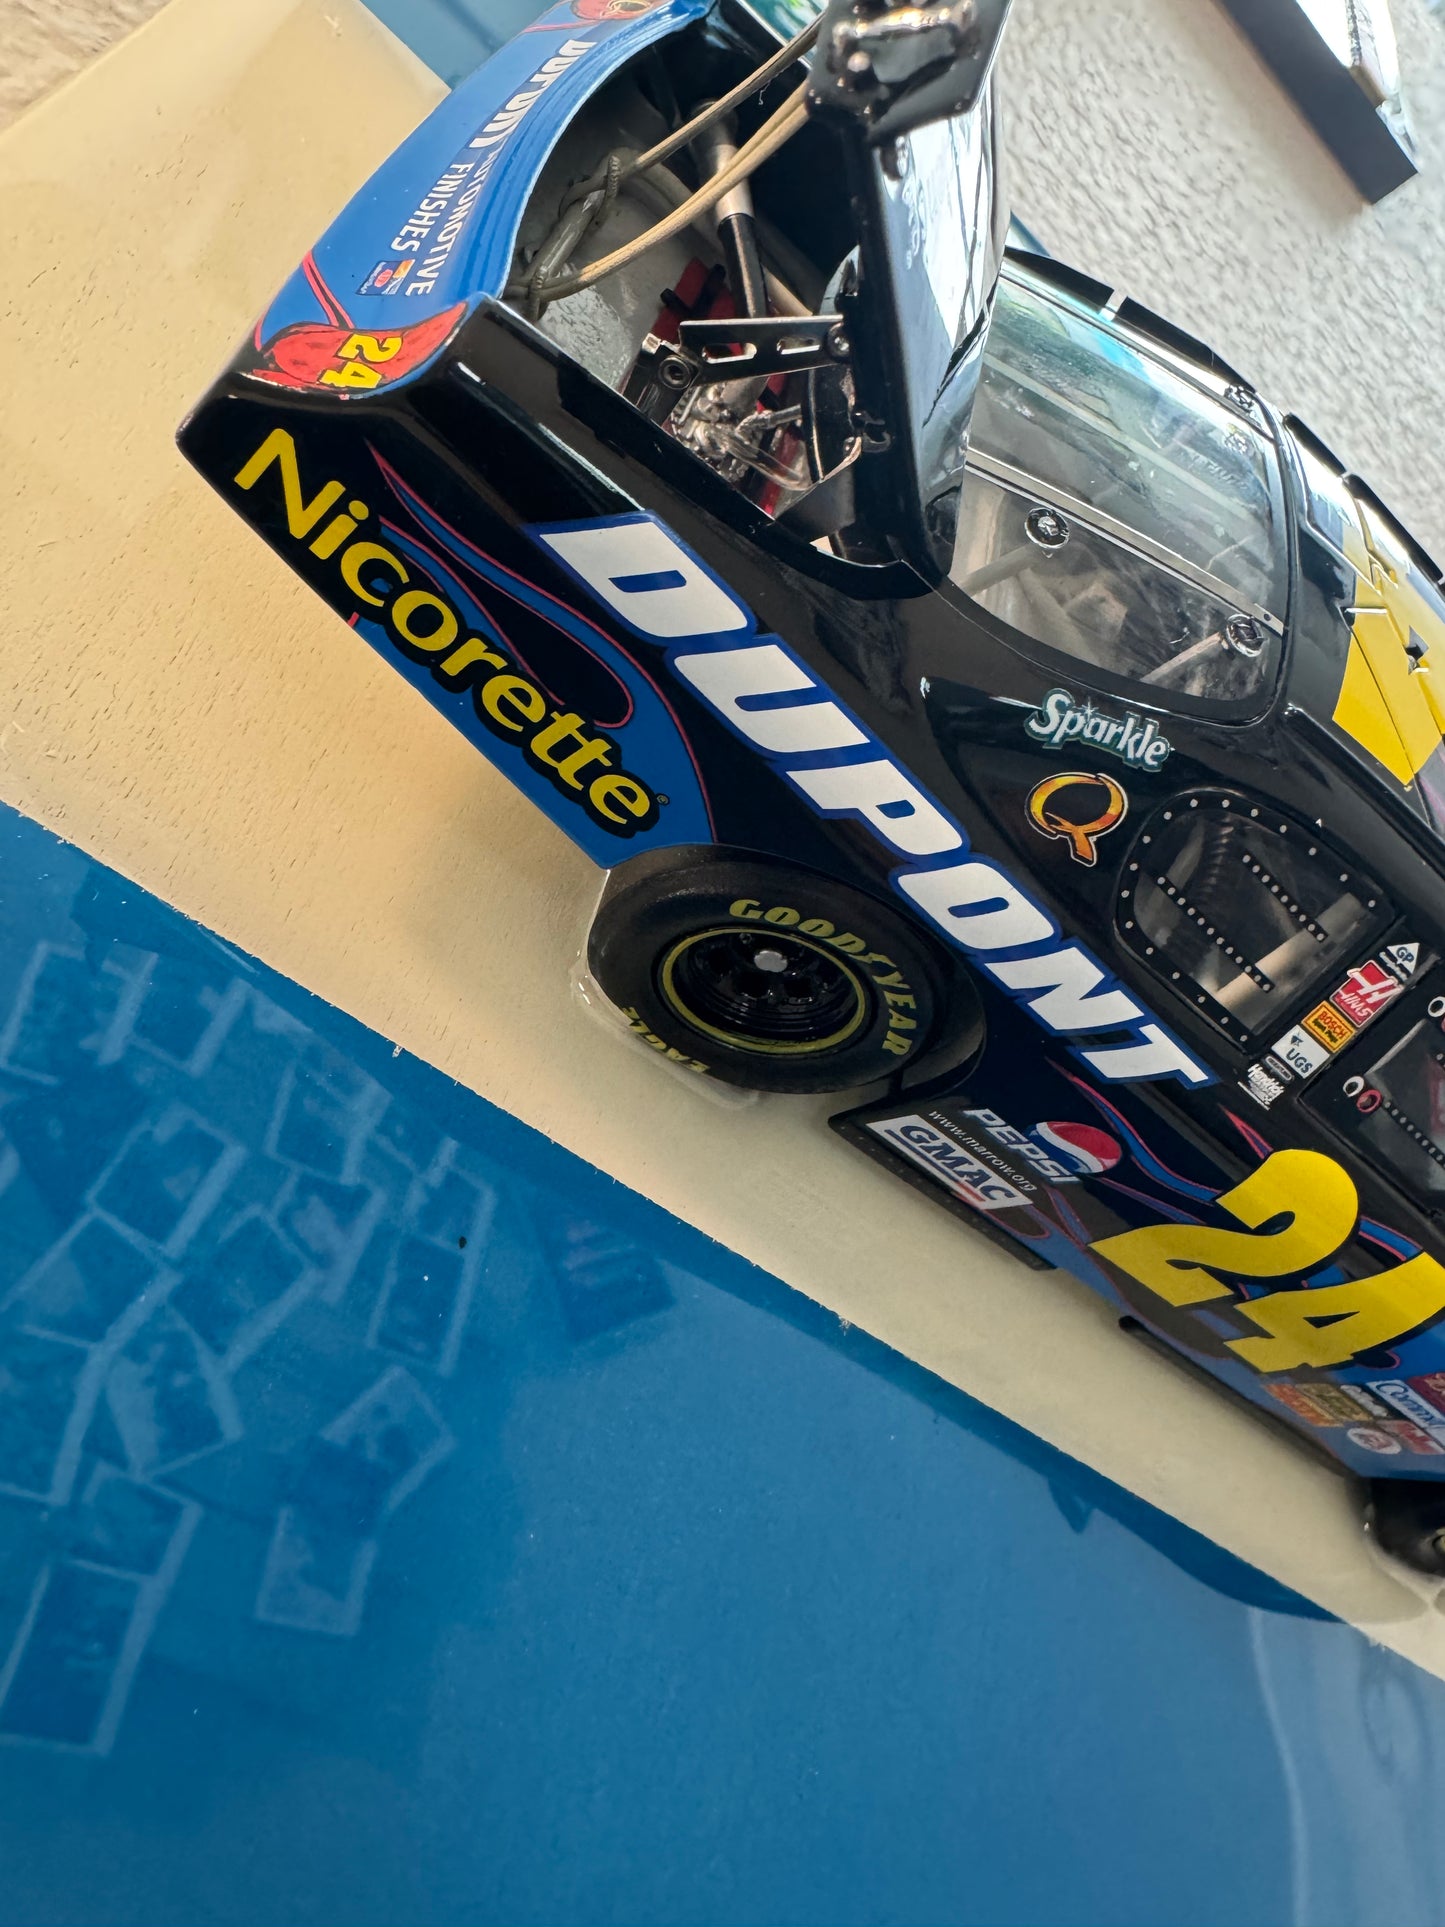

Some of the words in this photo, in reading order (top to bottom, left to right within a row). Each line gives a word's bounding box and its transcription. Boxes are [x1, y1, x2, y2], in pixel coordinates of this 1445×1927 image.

[391, 162, 475, 252] FINISHES
[319, 333, 404, 389] 24
[233, 427, 651, 825] Nicorette
[1026, 690, 1169, 770] Sparkle
[537, 520, 1209, 1084] DUPONT
[729, 899, 917, 1055] GOODYEAR
[1396, 946, 1415, 963] GP
[1285, 1048, 1314, 1074] UGS
[1319, 1010, 1348, 1038] BOSCH
[899, 1124, 1017, 1201] GMAC
[928, 1110, 1038, 1191] www.marrow.org
[963, 1108, 1081, 1183] PEPSI
[1087, 1148, 1445, 1374] 24
